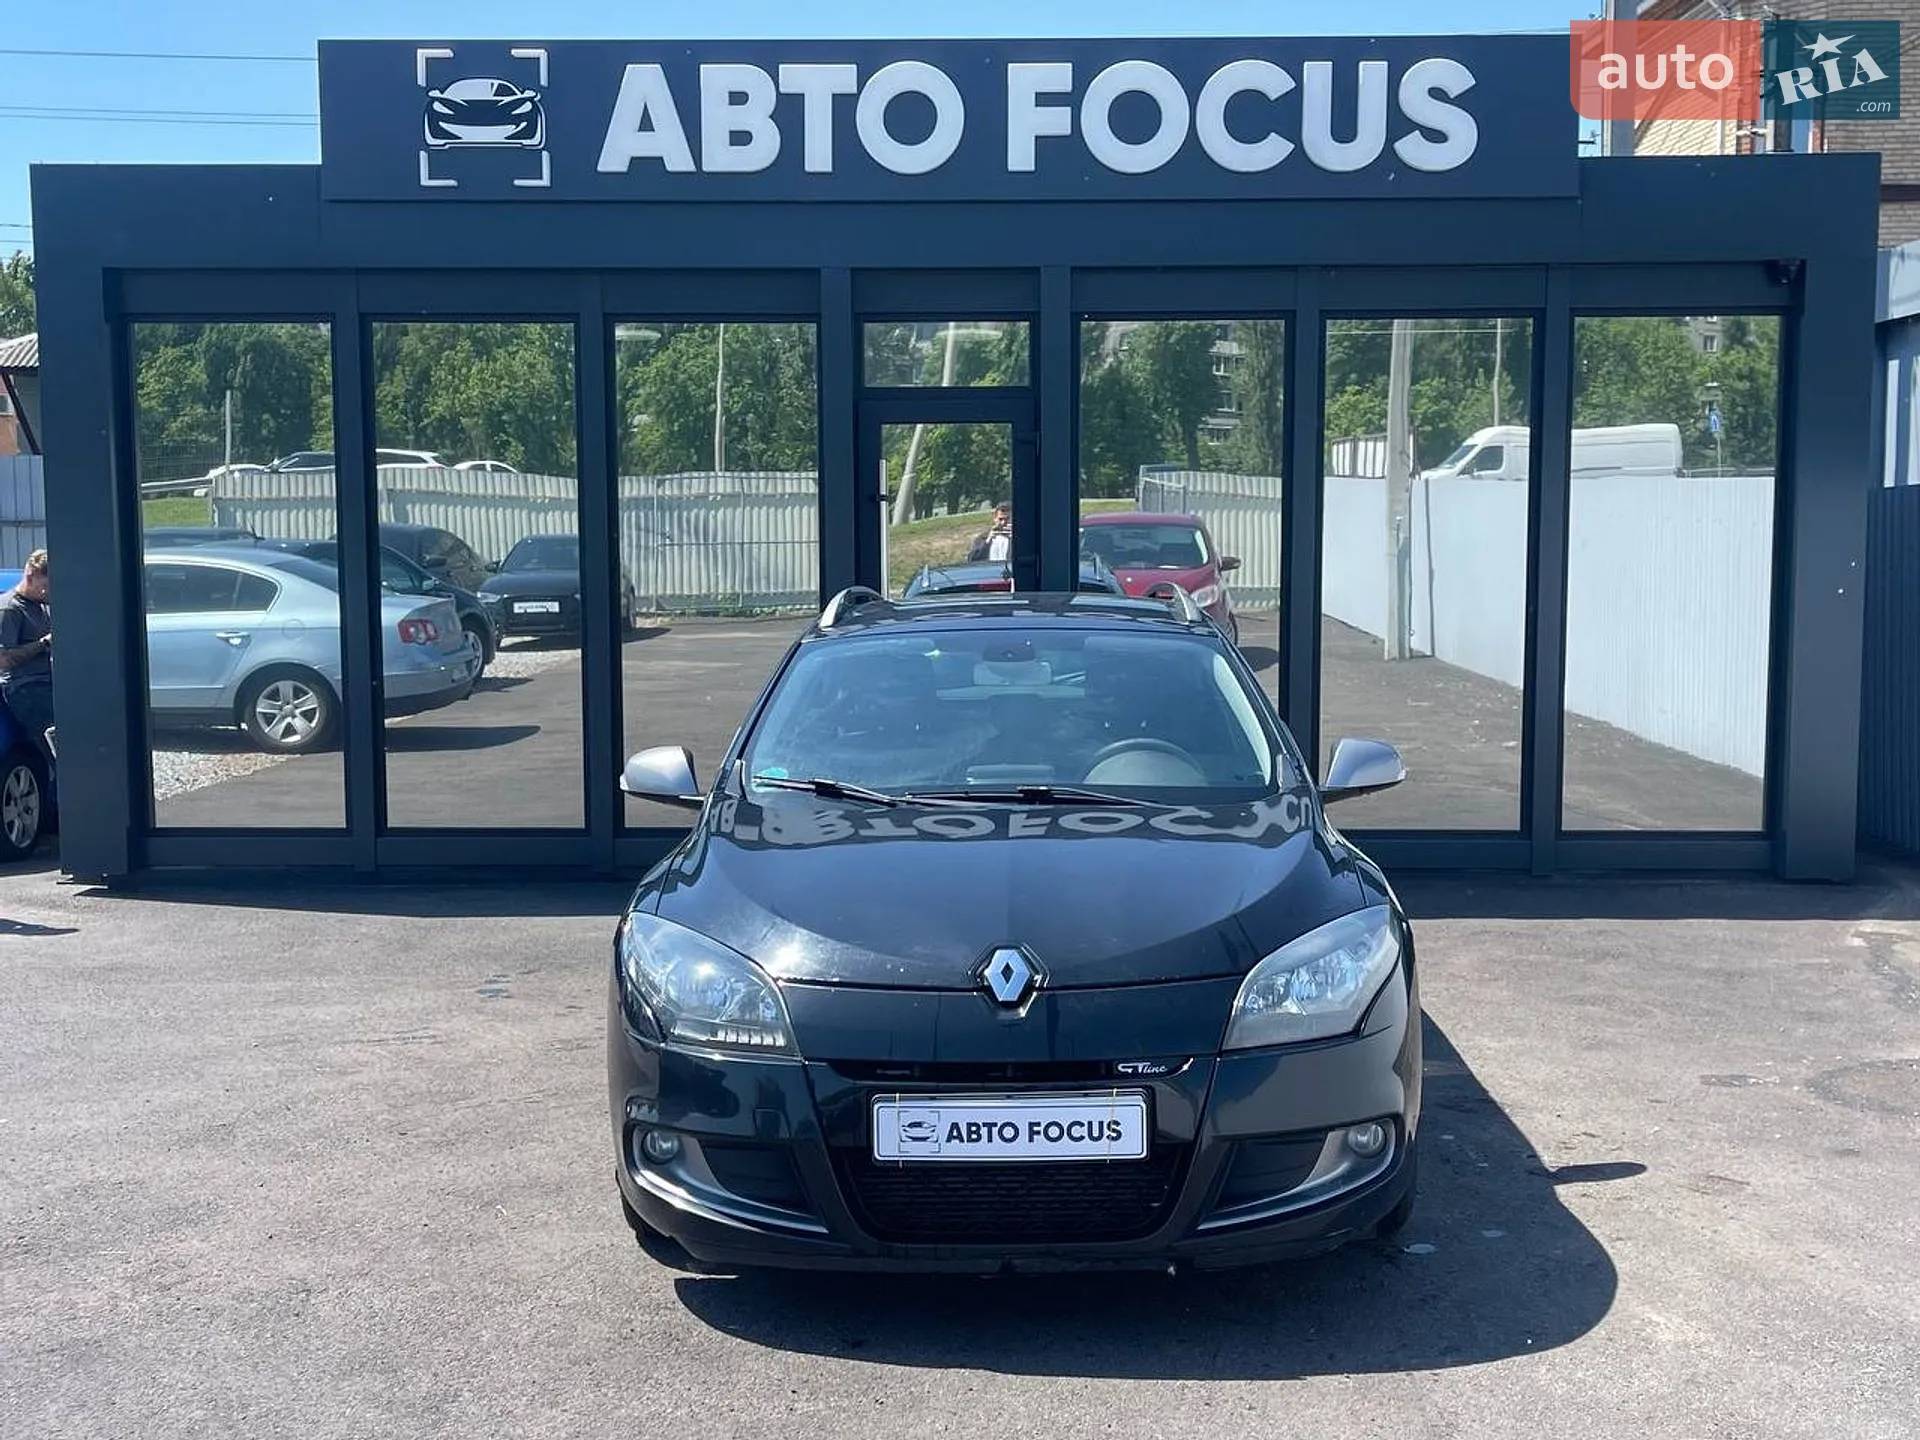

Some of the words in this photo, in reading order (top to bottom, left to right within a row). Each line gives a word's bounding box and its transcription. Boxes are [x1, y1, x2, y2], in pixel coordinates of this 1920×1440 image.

[597, 60, 965, 174] АВТО
[1007, 58, 1478, 173] FOCUS
[945, 1121, 1020, 1143] АВТО
[1028, 1119, 1122, 1143] FOCUS
